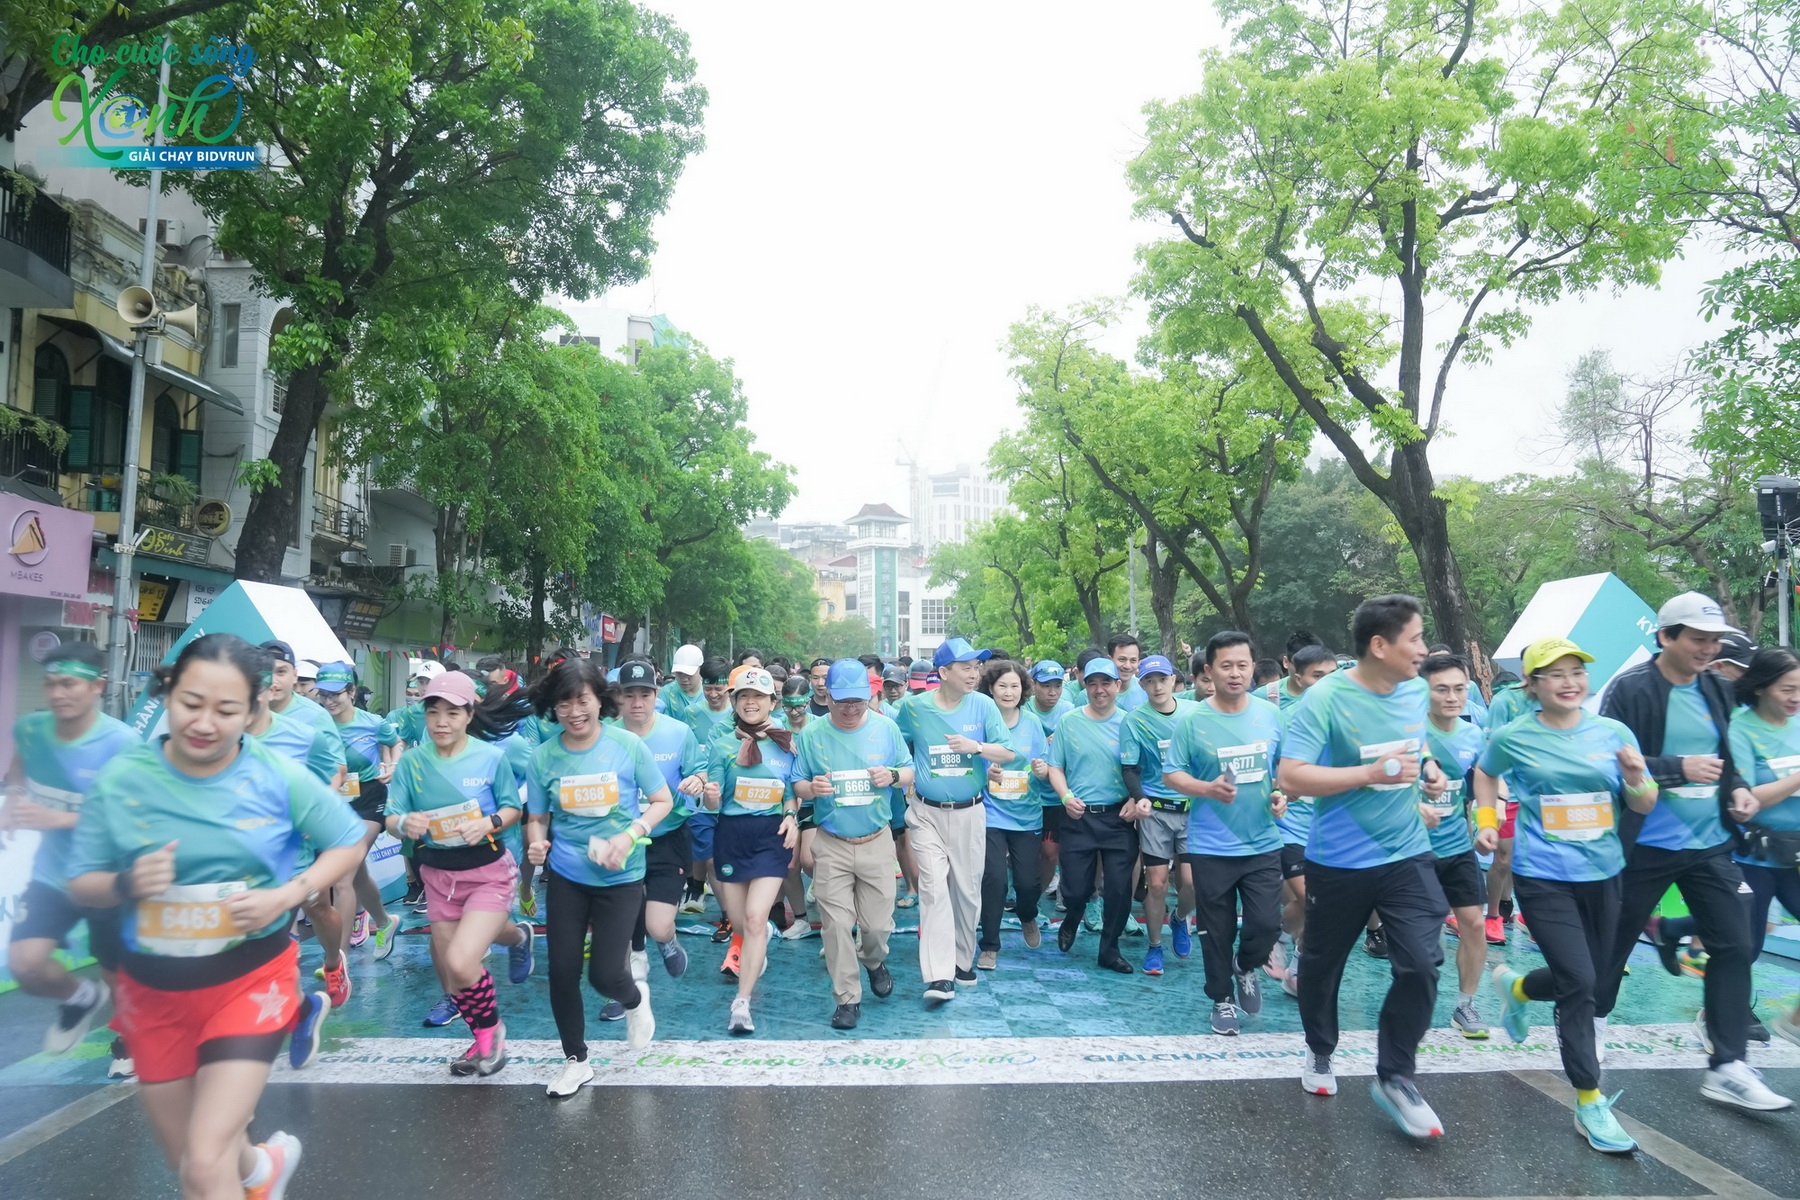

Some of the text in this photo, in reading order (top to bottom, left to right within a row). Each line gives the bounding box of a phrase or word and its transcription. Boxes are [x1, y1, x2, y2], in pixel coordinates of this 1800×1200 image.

[654, 752, 674, 761] BIDV
[941, 754, 961, 764] 8888
[1232, 755, 1255, 771] 6777
[463, 777, 487, 787] BIDV
[844, 780, 871, 793] 6666
[574, 786, 605, 802] 6368
[747, 788, 771, 800] 6732
[162, 906, 221, 930] 6463
